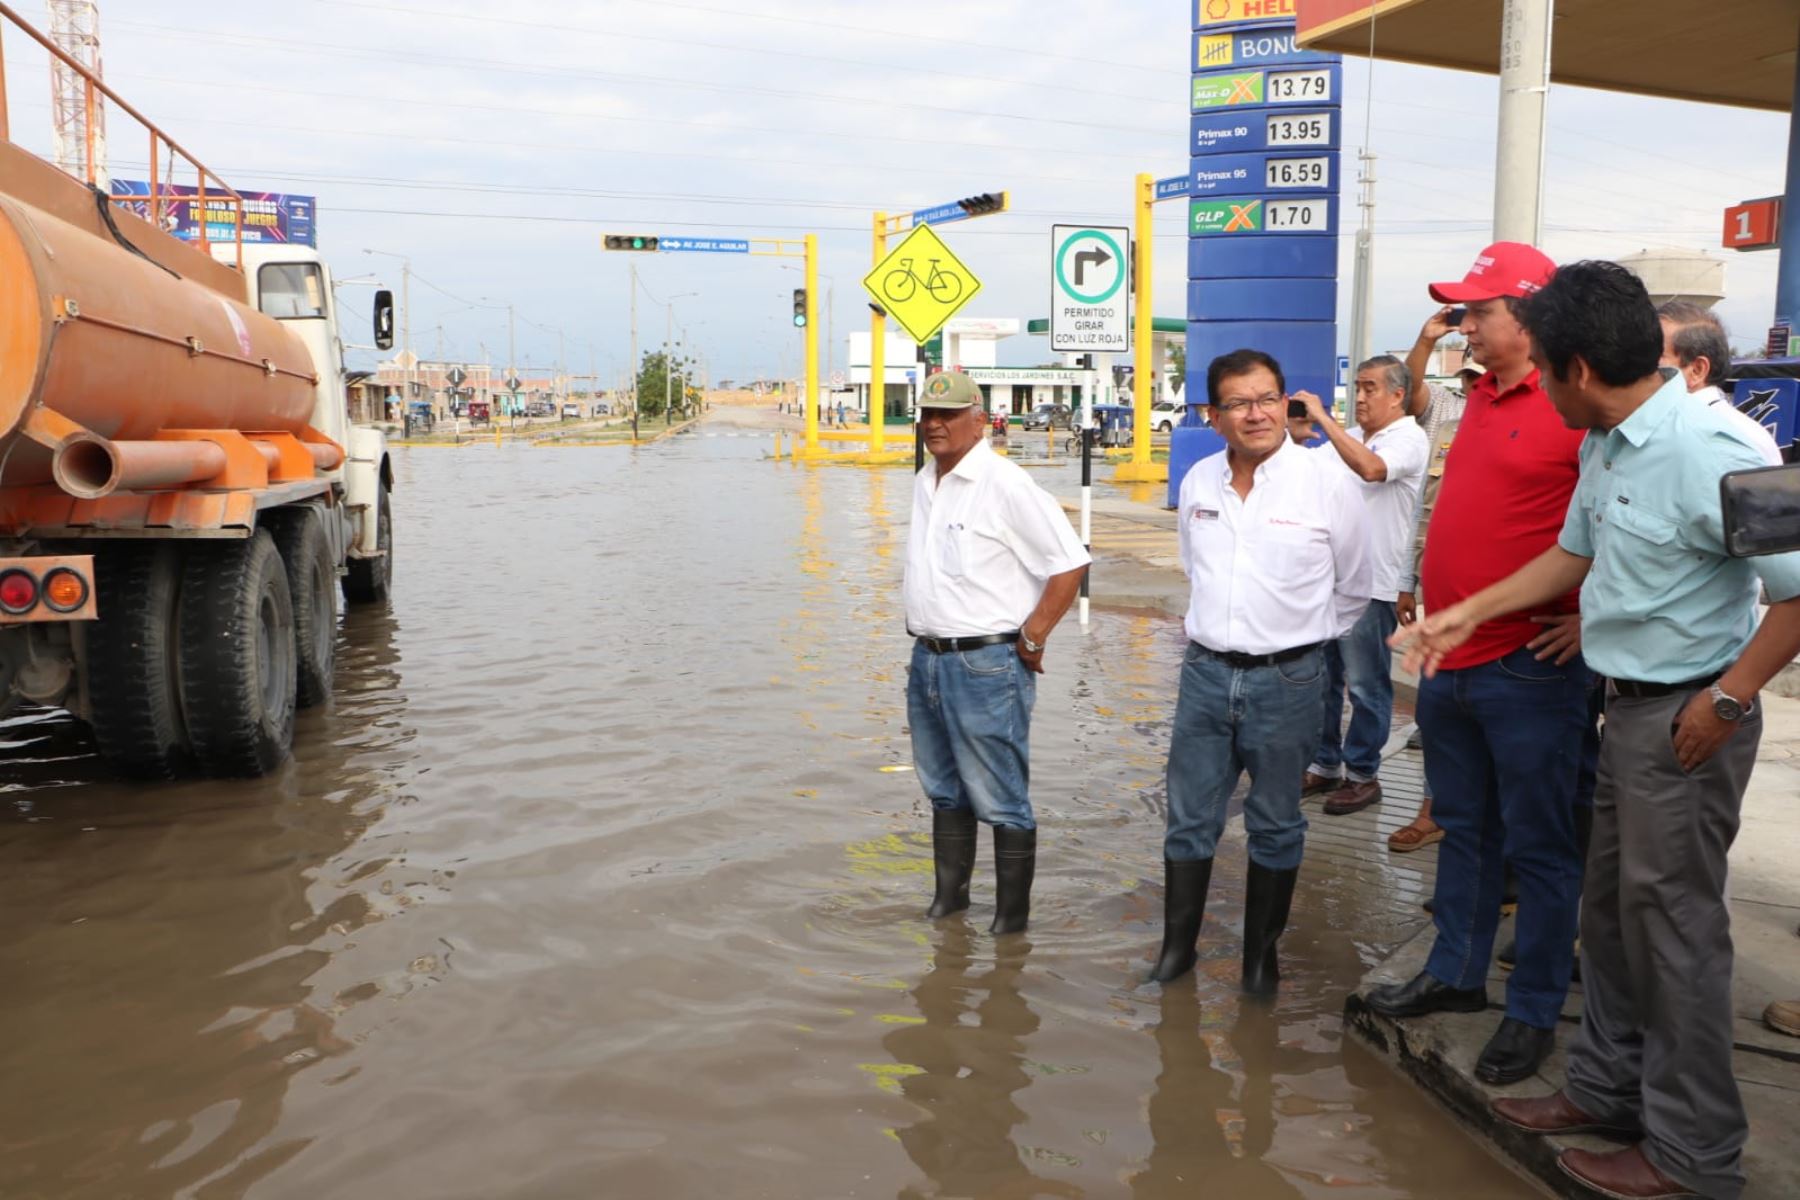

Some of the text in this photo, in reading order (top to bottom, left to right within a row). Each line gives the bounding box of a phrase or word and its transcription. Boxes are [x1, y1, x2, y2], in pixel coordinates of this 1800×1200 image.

[1272, 77, 1326, 96] 13.79
[1198, 126, 1248, 139] Primax 90
[1269, 120, 1321, 141] 13.95
[1197, 169, 1247, 181] Primax 95
[1269, 163, 1323, 183] 16.59
[1195, 211, 1224, 223] GLP
[1270, 206, 1312, 226] 1.70
[1734, 210, 1753, 240] 1
[1064, 307, 1115, 318] PERMITIDO
[1074, 321, 1104, 331] GIRAR
[1055, 333, 1124, 344] CON LUZ ROJA
[970, 370, 1006, 380] SERVICIOS
